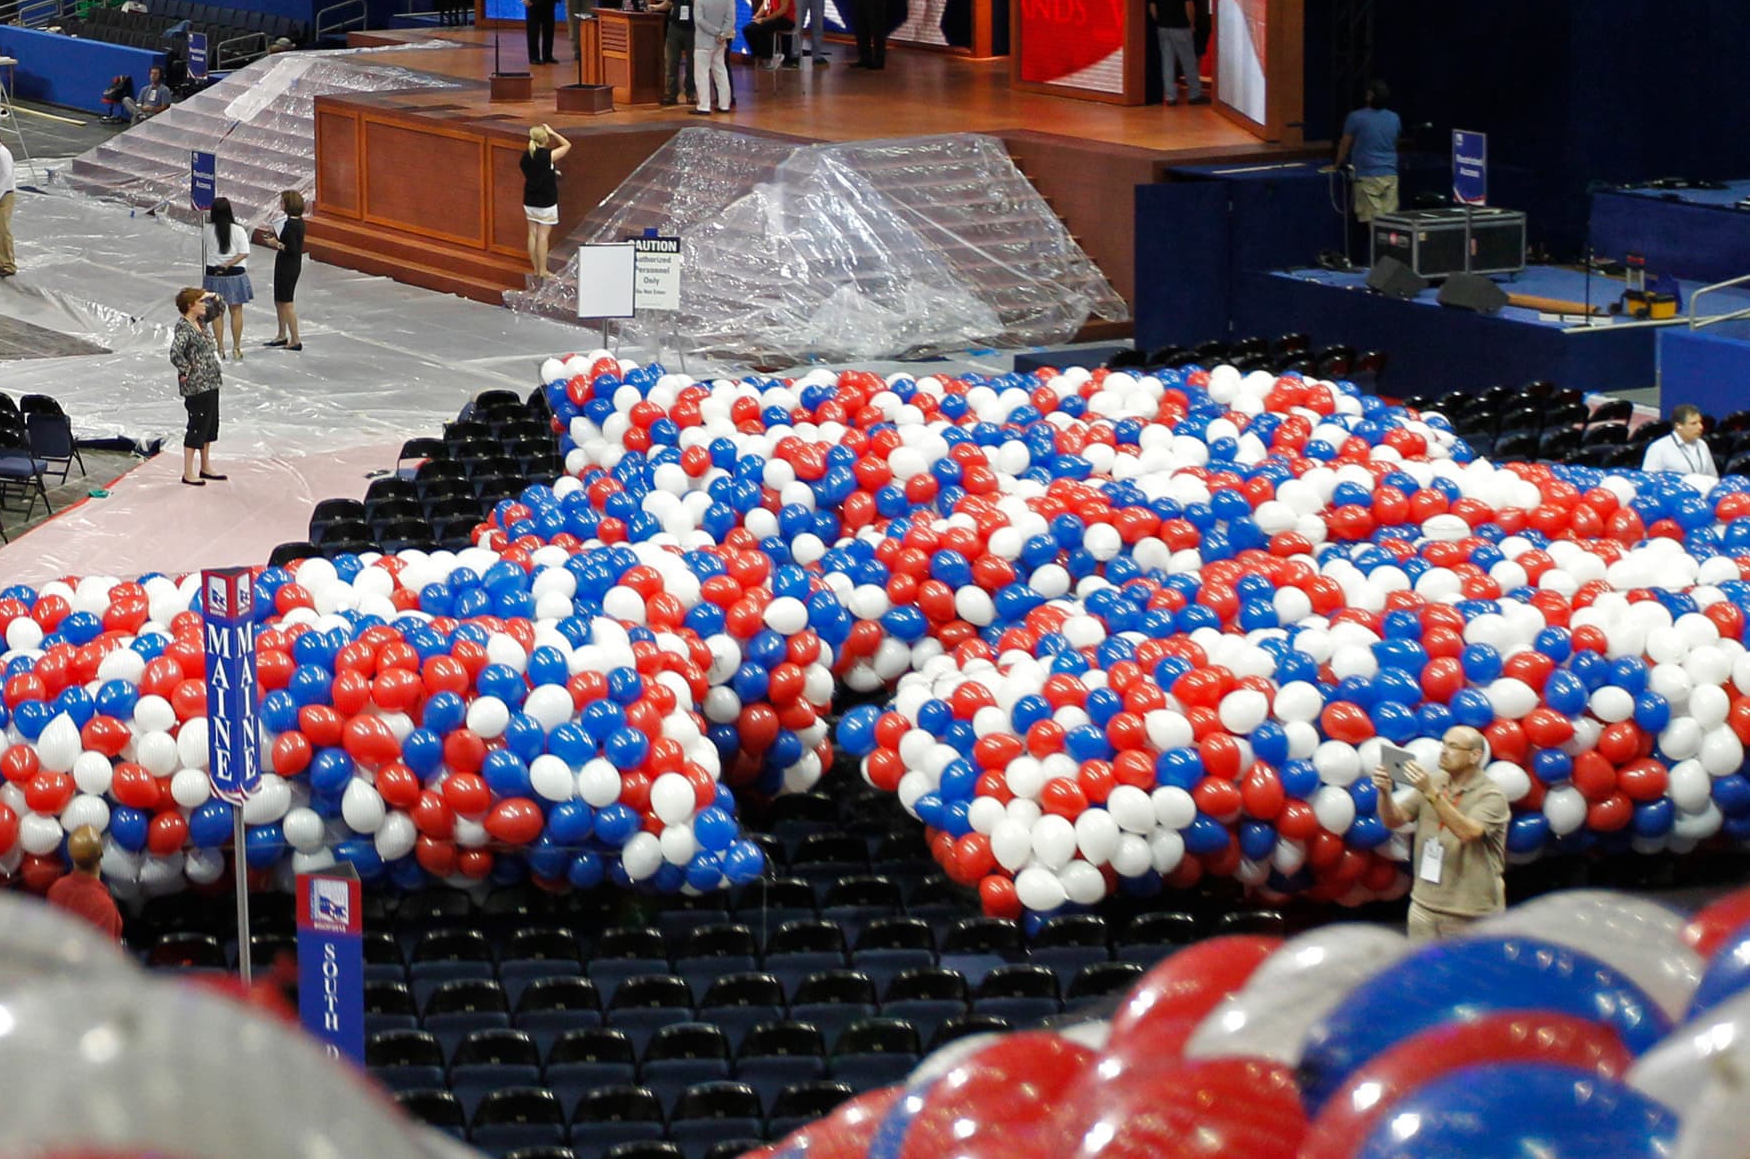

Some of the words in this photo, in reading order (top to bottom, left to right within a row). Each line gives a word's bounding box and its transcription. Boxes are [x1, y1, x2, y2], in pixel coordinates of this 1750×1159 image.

[637, 256, 672, 264] uthorized
[206, 622, 233, 782] MAINE
[236, 620, 256, 782] MAINE
[322, 942, 340, 1032] SOUTH
